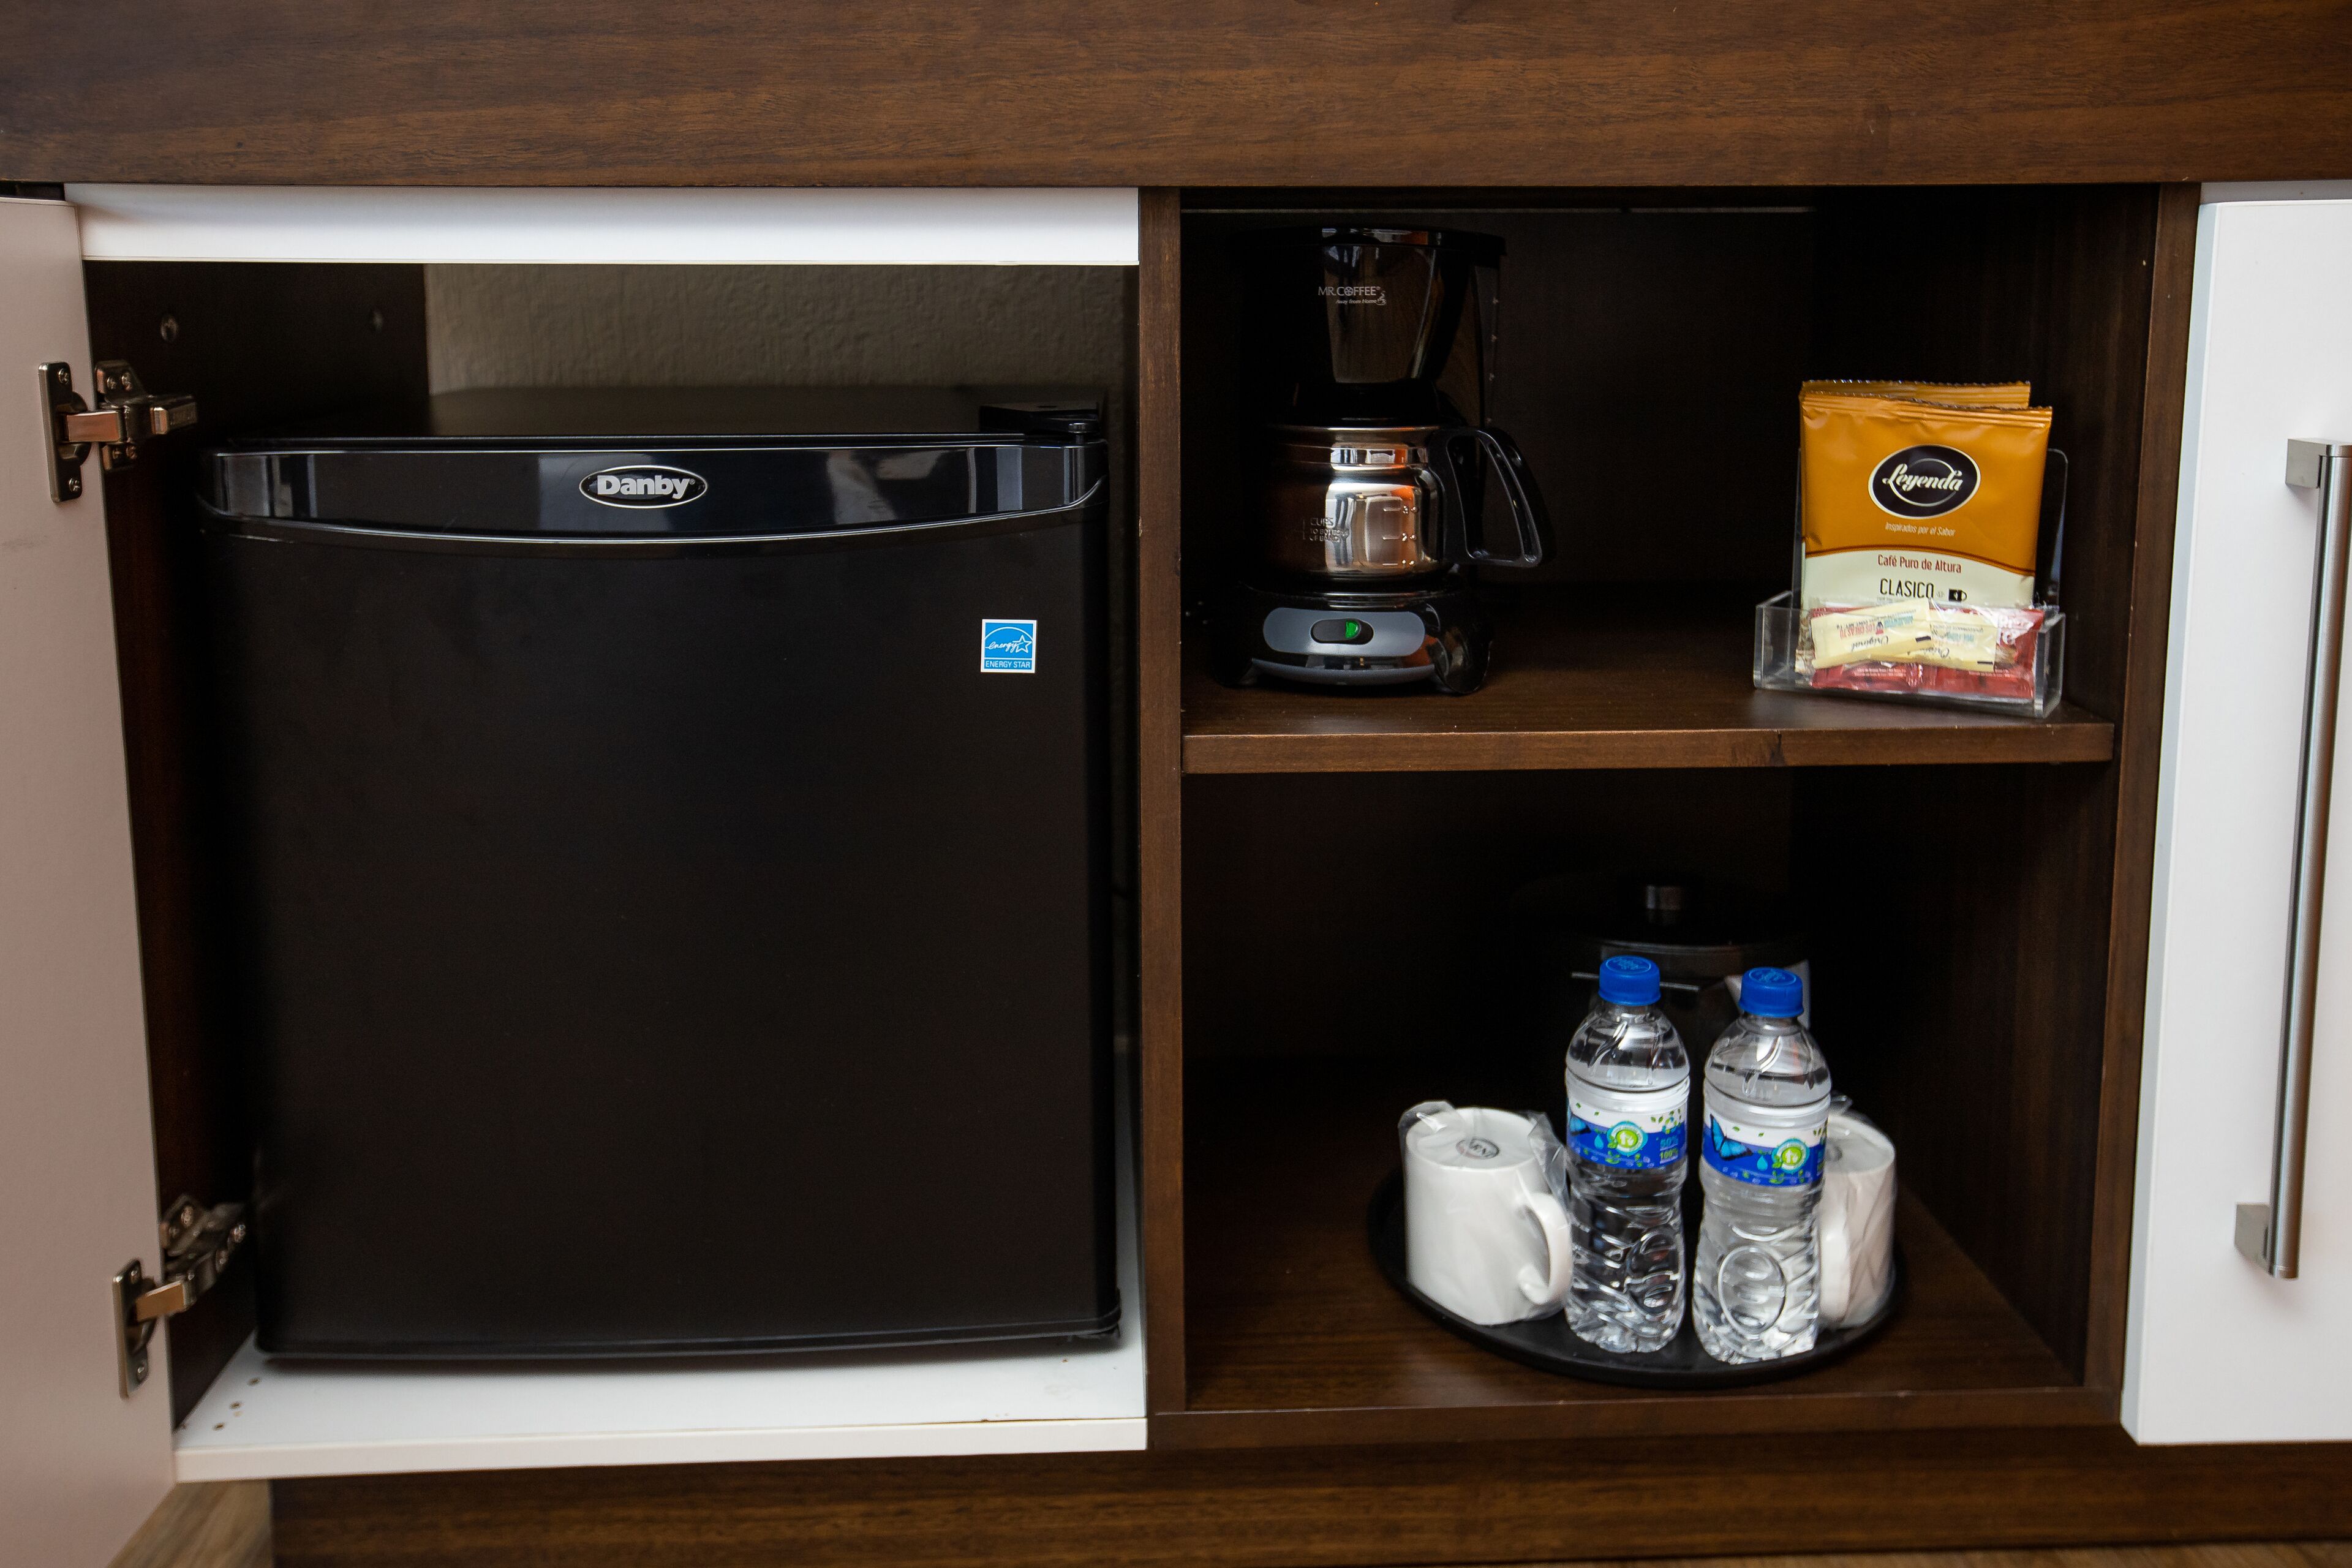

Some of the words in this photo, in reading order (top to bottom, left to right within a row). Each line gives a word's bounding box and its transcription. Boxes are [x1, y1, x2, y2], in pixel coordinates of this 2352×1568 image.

[1882, 463, 1963, 491] Leyenda
[597, 475, 690, 499] Danby
[1310, 517, 1334, 527] CUPS
[1885, 522, 1917, 533] Inspirados
[1918, 526, 1929, 535] por
[1930, 527, 1937, 535] el
[1937, 526, 1956, 537] Sabor
[1877, 554, 1897, 567] Café
[1899, 556, 1919, 569] Puro
[1921, 558, 1932, 570] de
[1935, 560, 1962, 574] Altura
[1880, 578, 1934, 598] CLASICO
[1851, 636, 1888, 652] Original
[1660, 1148, 1678, 1159] 100%
